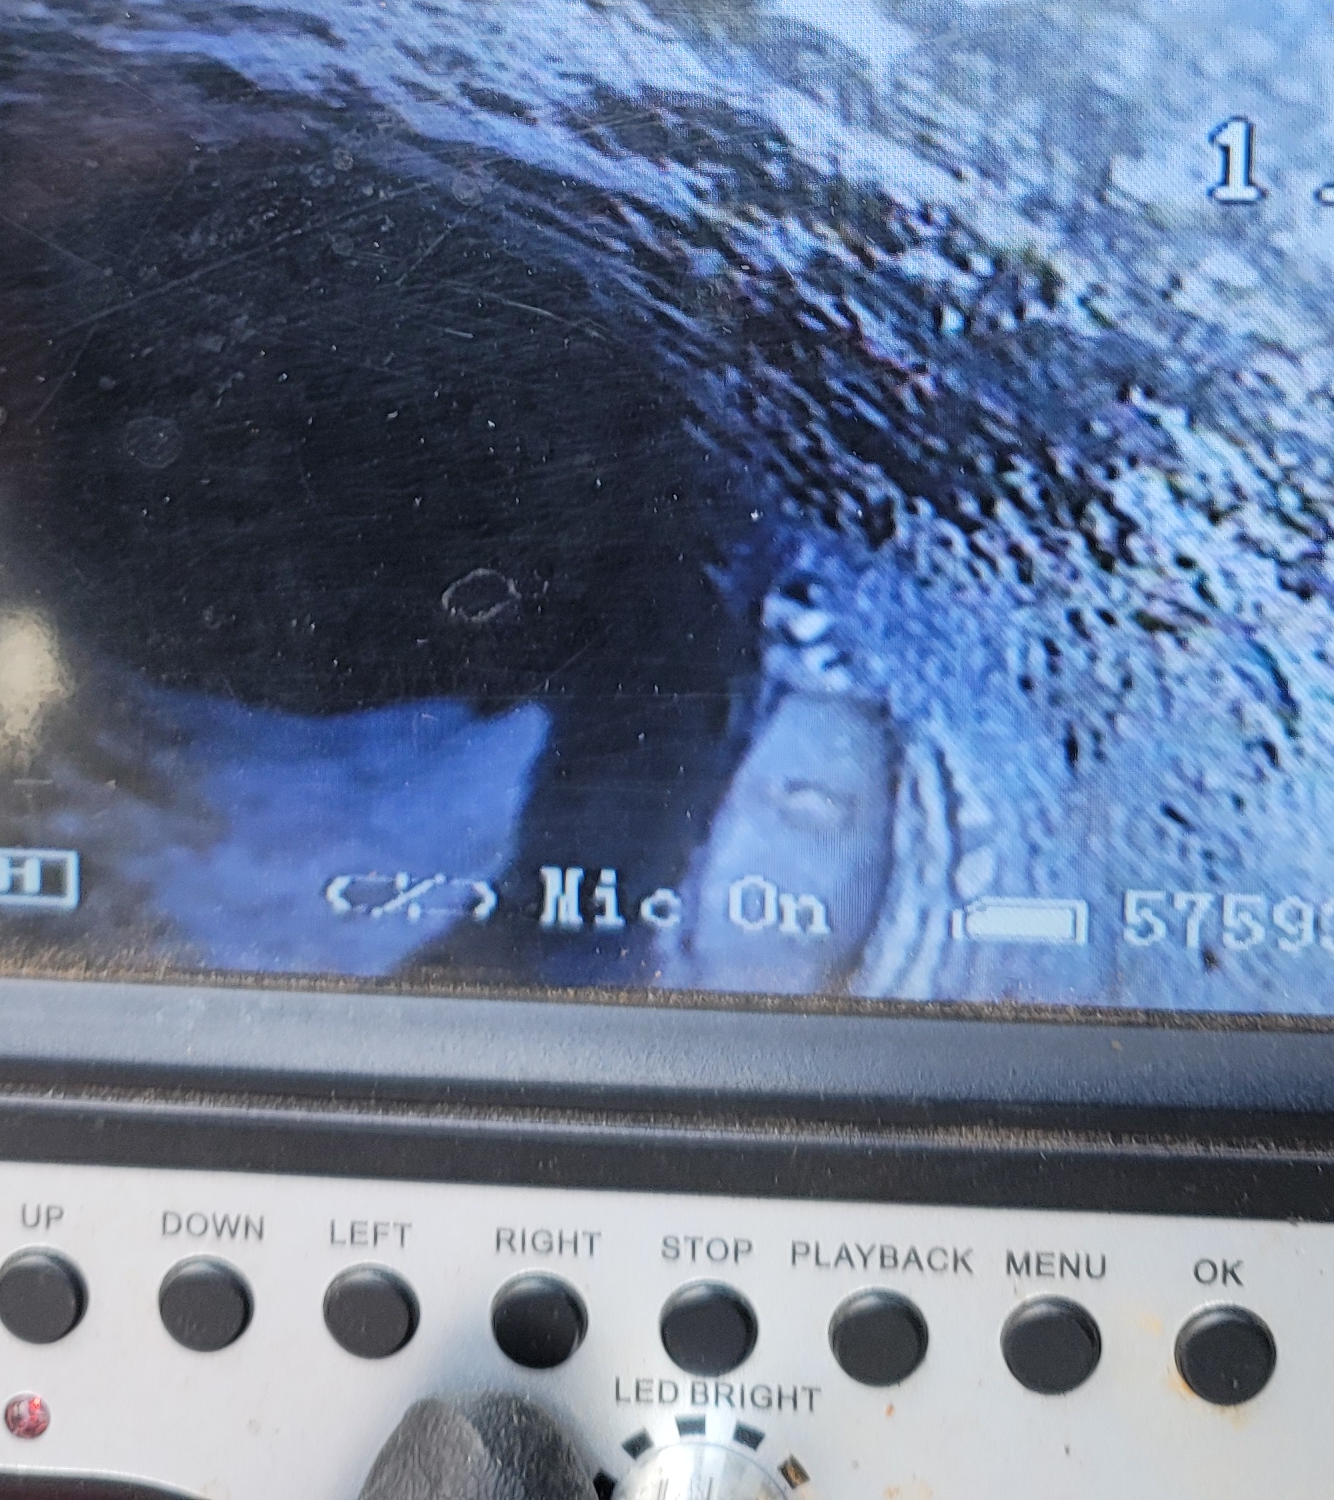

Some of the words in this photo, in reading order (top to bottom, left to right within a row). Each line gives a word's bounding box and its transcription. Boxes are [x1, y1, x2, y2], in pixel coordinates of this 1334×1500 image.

[539, 865, 684, 931] Mic
[727, 874, 832, 935] On
[19, 1203, 66, 1230] UP
[161, 1210, 265, 1243] DOWN
[328, 1219, 413, 1250] LEFT
[494, 1226, 603, 1259] RIGHT
[660, 1235, 754, 1265] STOP
[790, 1240, 975, 1276] PLAYBACK
[1004, 1250, 1109, 1282] MENU
[1192, 1257, 1245, 1288] OK
[614, 1376, 680, 1405] LED
[690, 1378, 823, 1413] BRIGHT
